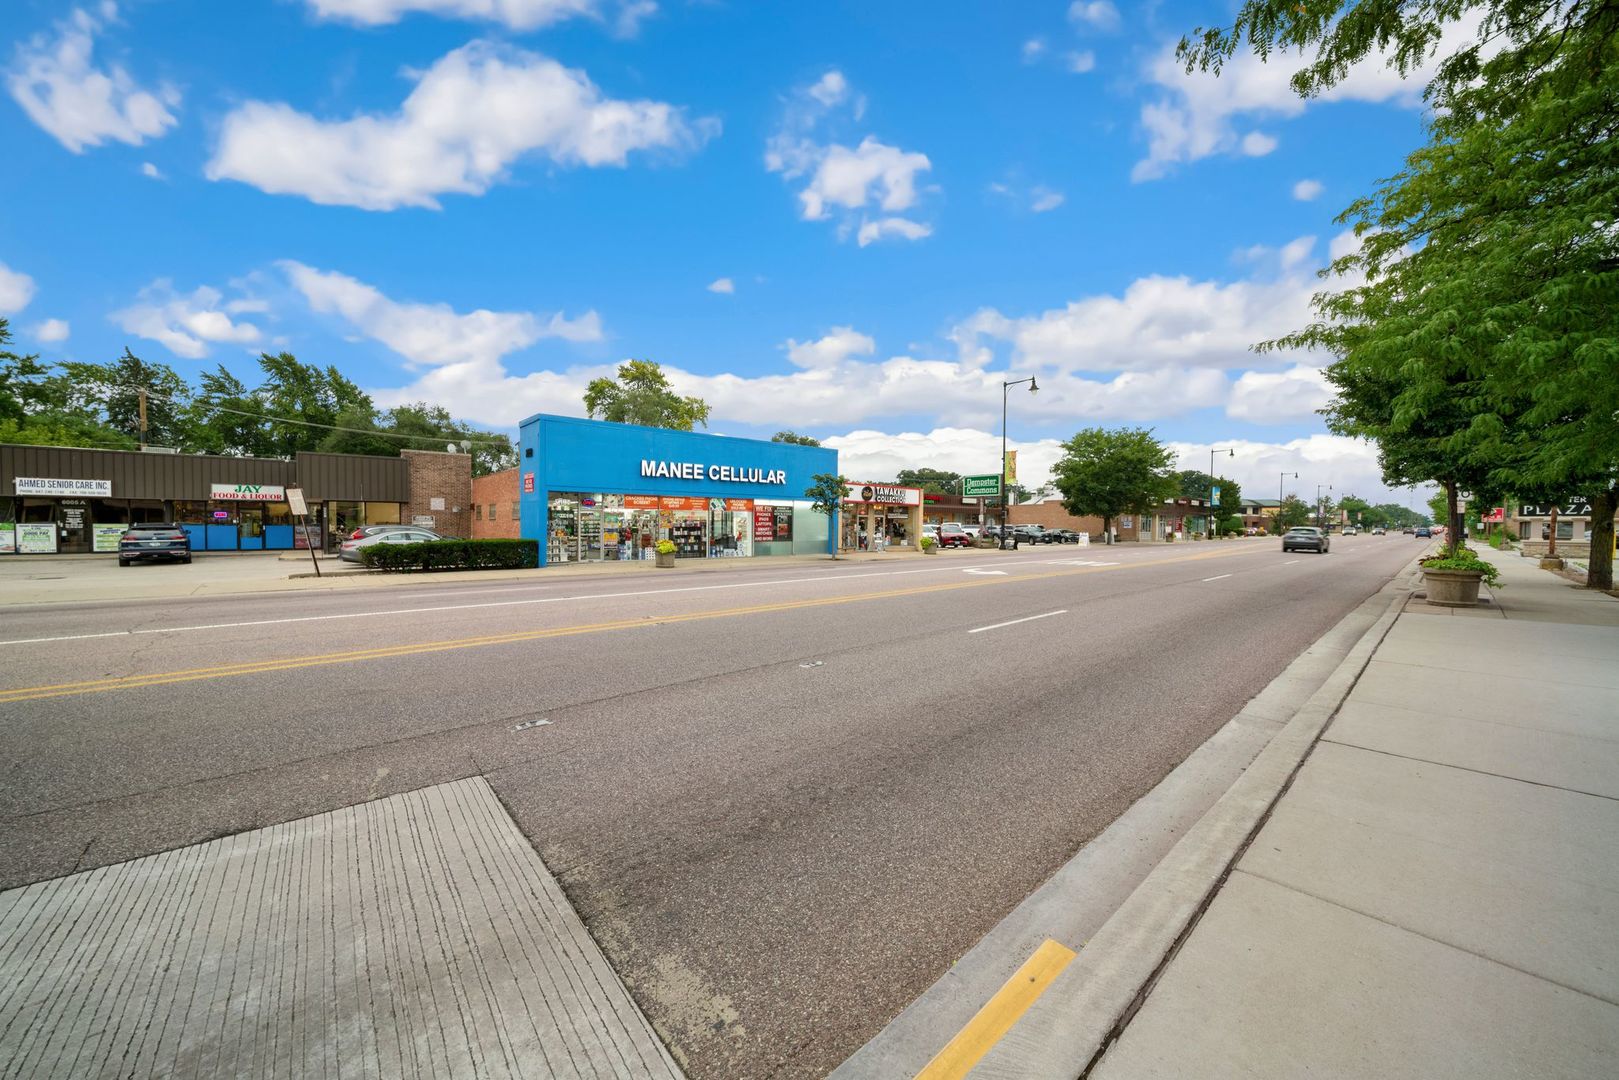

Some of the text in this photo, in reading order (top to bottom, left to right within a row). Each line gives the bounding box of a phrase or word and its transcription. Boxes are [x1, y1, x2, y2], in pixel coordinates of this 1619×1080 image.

[641, 459, 786, 485] MANEE CELLULAR
[18, 479, 110, 491] AHMED SENIOR CARE INC.
[966, 478, 997, 487] Dempster
[234, 484, 262, 493] JAY
